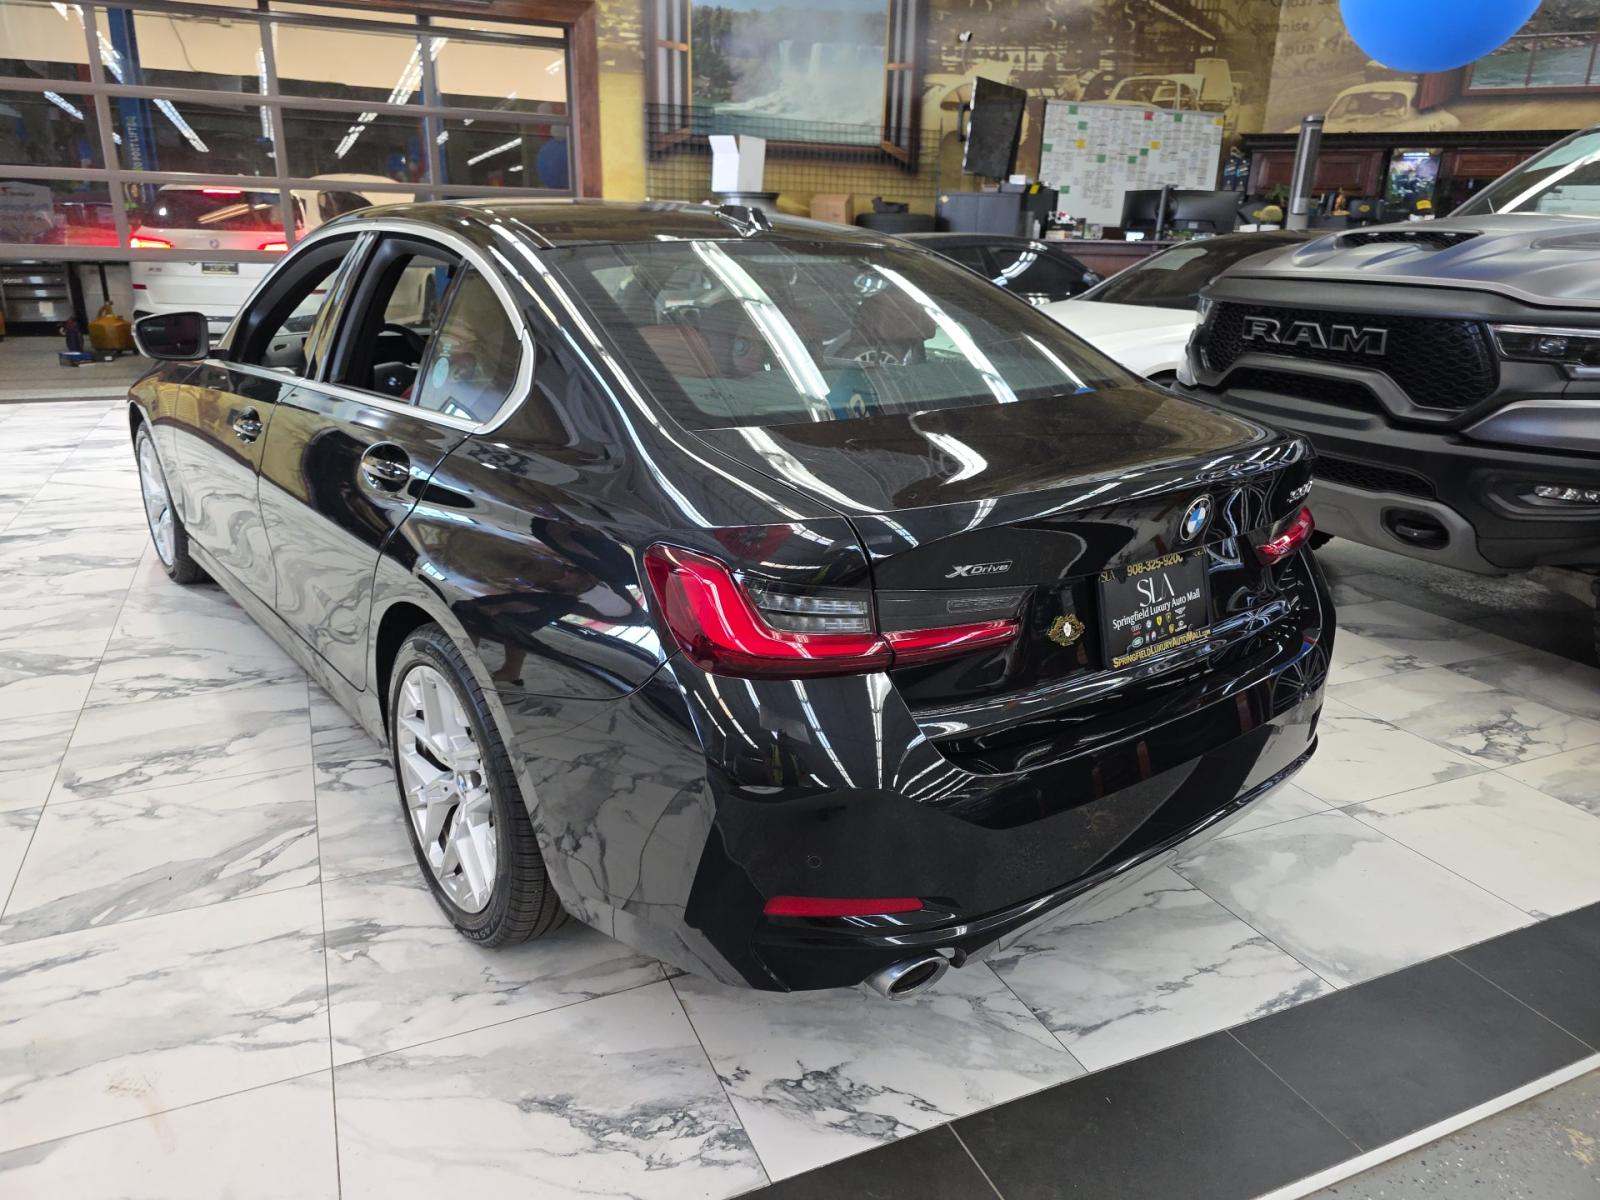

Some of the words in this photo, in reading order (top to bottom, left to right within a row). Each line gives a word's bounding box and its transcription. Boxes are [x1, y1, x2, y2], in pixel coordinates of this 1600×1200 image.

[1242, 315, 1388, 355] RAM
[1112, 607, 1150, 630] Springfield
[1149, 601, 1171, 615] Luxury
[1171, 595, 1187, 607] Auto
[1186, 588, 1200, 601] Mall
[1137, 572, 1175, 607] SLA
